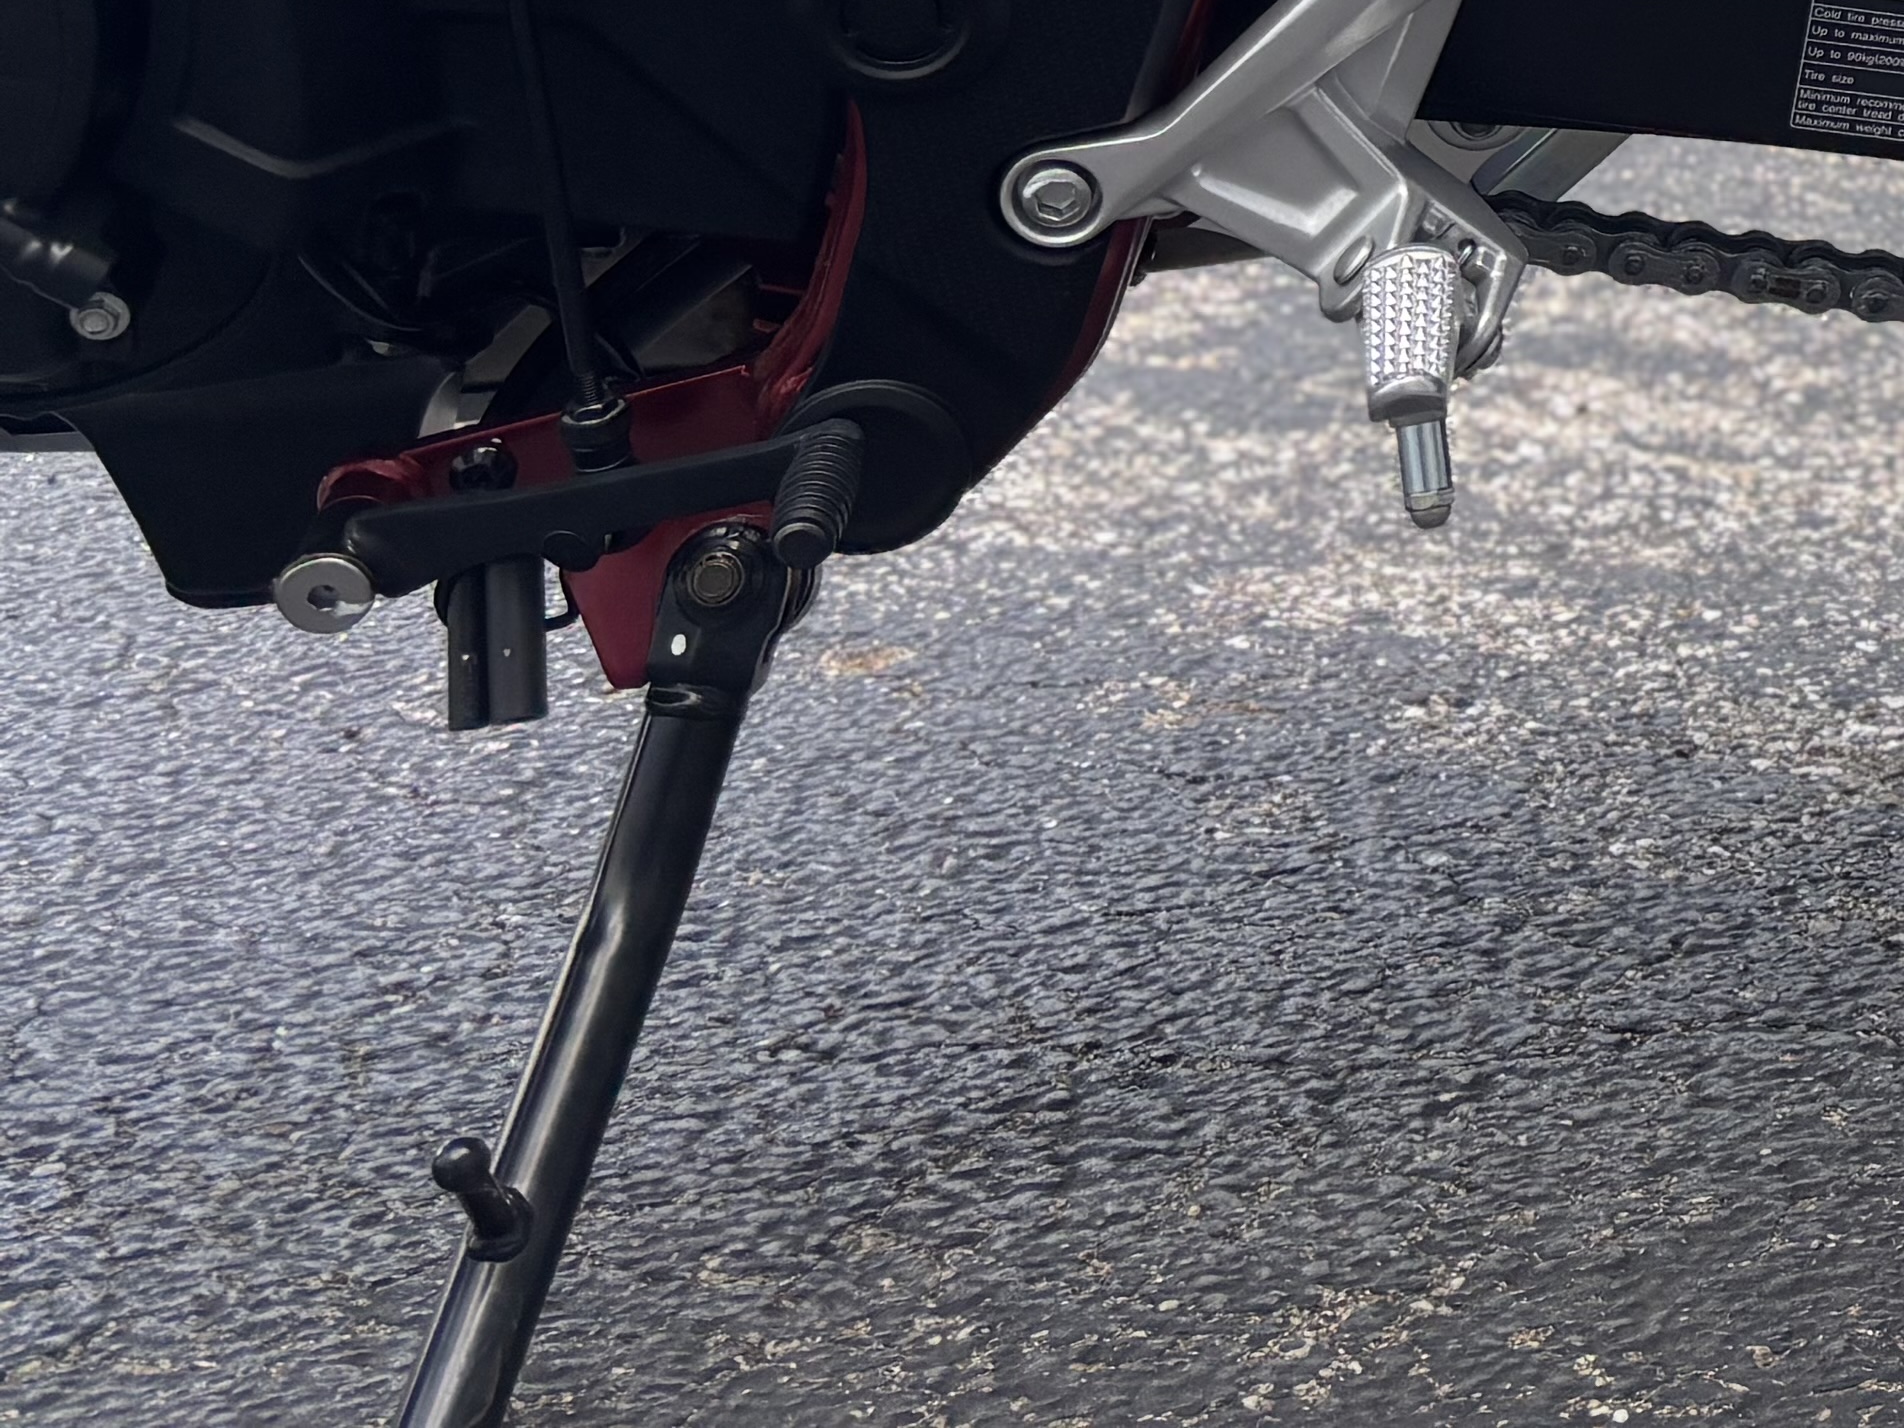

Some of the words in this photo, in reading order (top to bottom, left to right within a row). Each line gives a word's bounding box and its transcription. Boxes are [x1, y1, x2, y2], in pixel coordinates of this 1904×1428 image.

[1814, 7, 1841, 20] Cold
[1847, 12, 1865, 23] tire
[1811, 25, 1828, 37] Up
[1834, 28, 1845, 38] to
[1808, 46, 1824, 58] Up
[1830, 49, 1841, 59] to
[1804, 69, 1825, 81] Tire
[1831, 75, 1854, 84] size
[1799, 89, 1850, 104] Minimum
[1797, 100, 1816, 110] tire
[1821, 104, 1857, 115] center
[1863, 108, 1892, 120] tread
[1794, 114, 1850, 130] Maximum
[1856, 124, 1892, 135] weight
